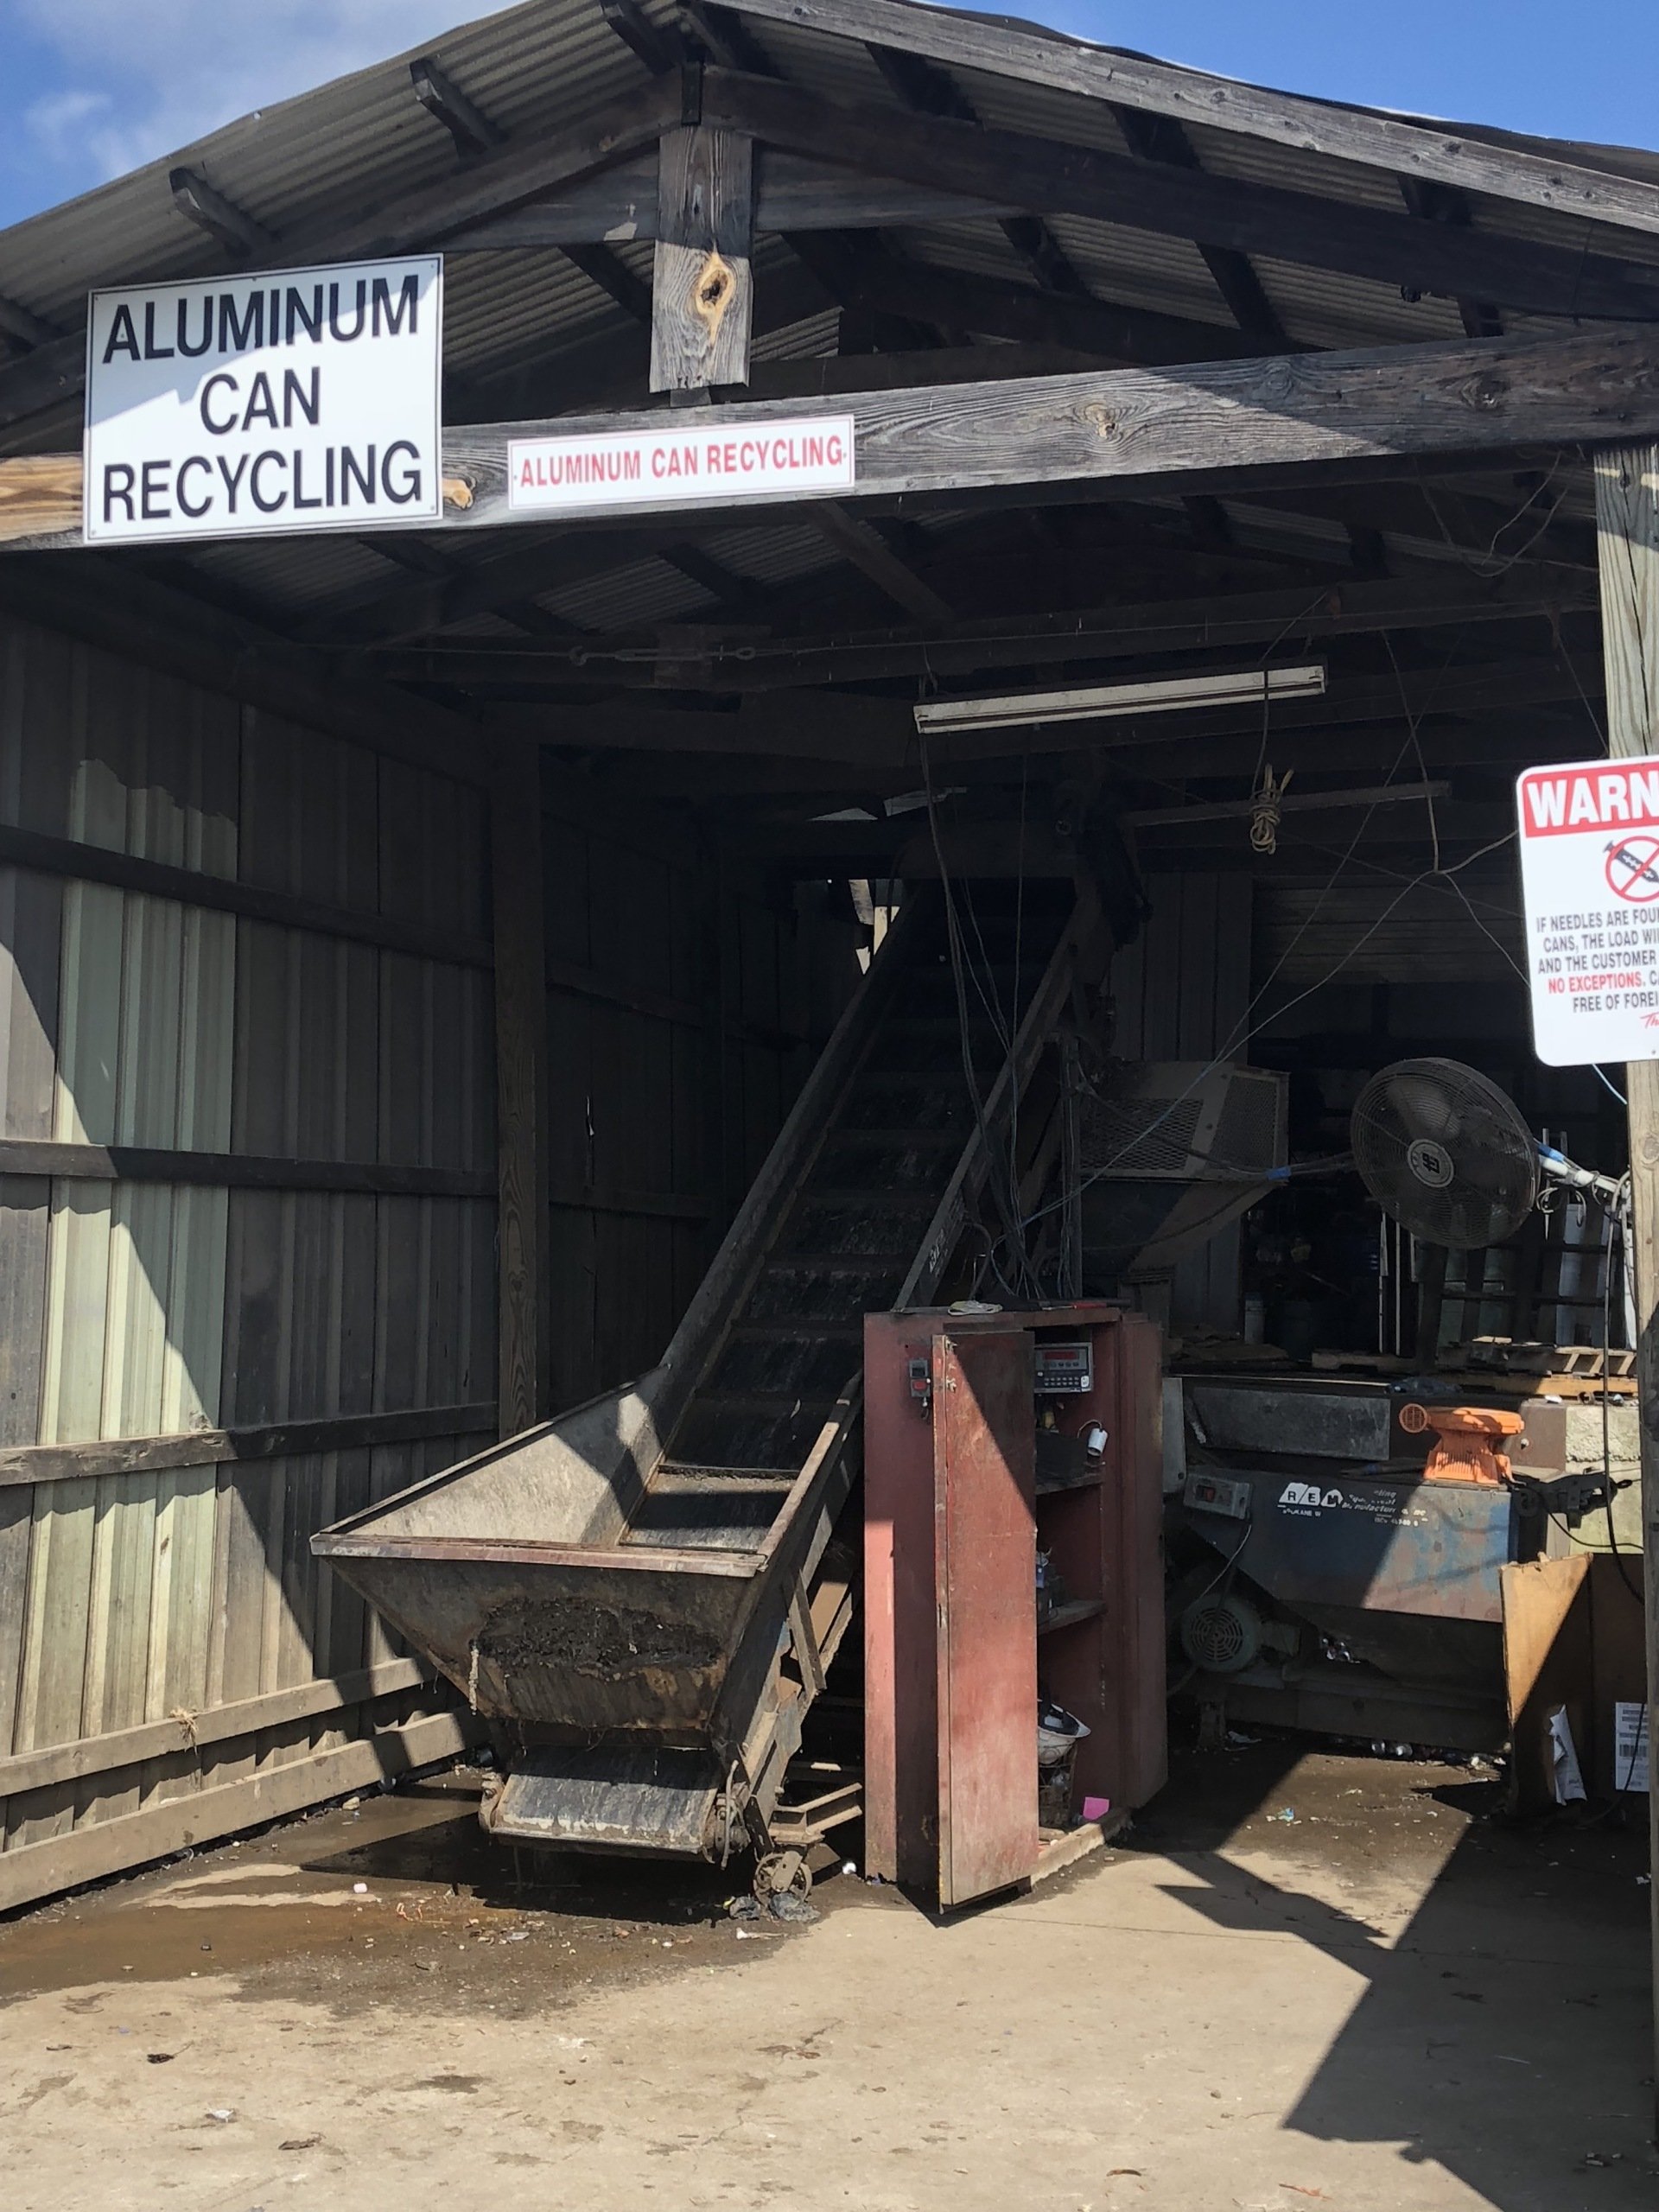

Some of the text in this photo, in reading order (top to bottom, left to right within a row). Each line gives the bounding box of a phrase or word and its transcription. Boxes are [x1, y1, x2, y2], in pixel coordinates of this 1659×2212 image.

[102, 274, 420, 364] ALUMINUM
[200, 366, 321, 435] CAN
[520, 435, 842, 488] ALUMINUM CAN RECYCLING
[103, 439, 422, 524] RECYCLING
[1526, 770, 1659, 829] WARN
[1536, 907, 1659, 933] IF NEEDLES ARE FOU
[1543, 928, 1659, 954] CANS, THE LOAD WI
[1538, 950, 1657, 974] AND THE CUSTOMER
[1548, 977, 1566, 995] NO
[1569, 971, 1646, 993] EXCEPTIONS.
[1573, 990, 1659, 1013] FREE OF FOREI
